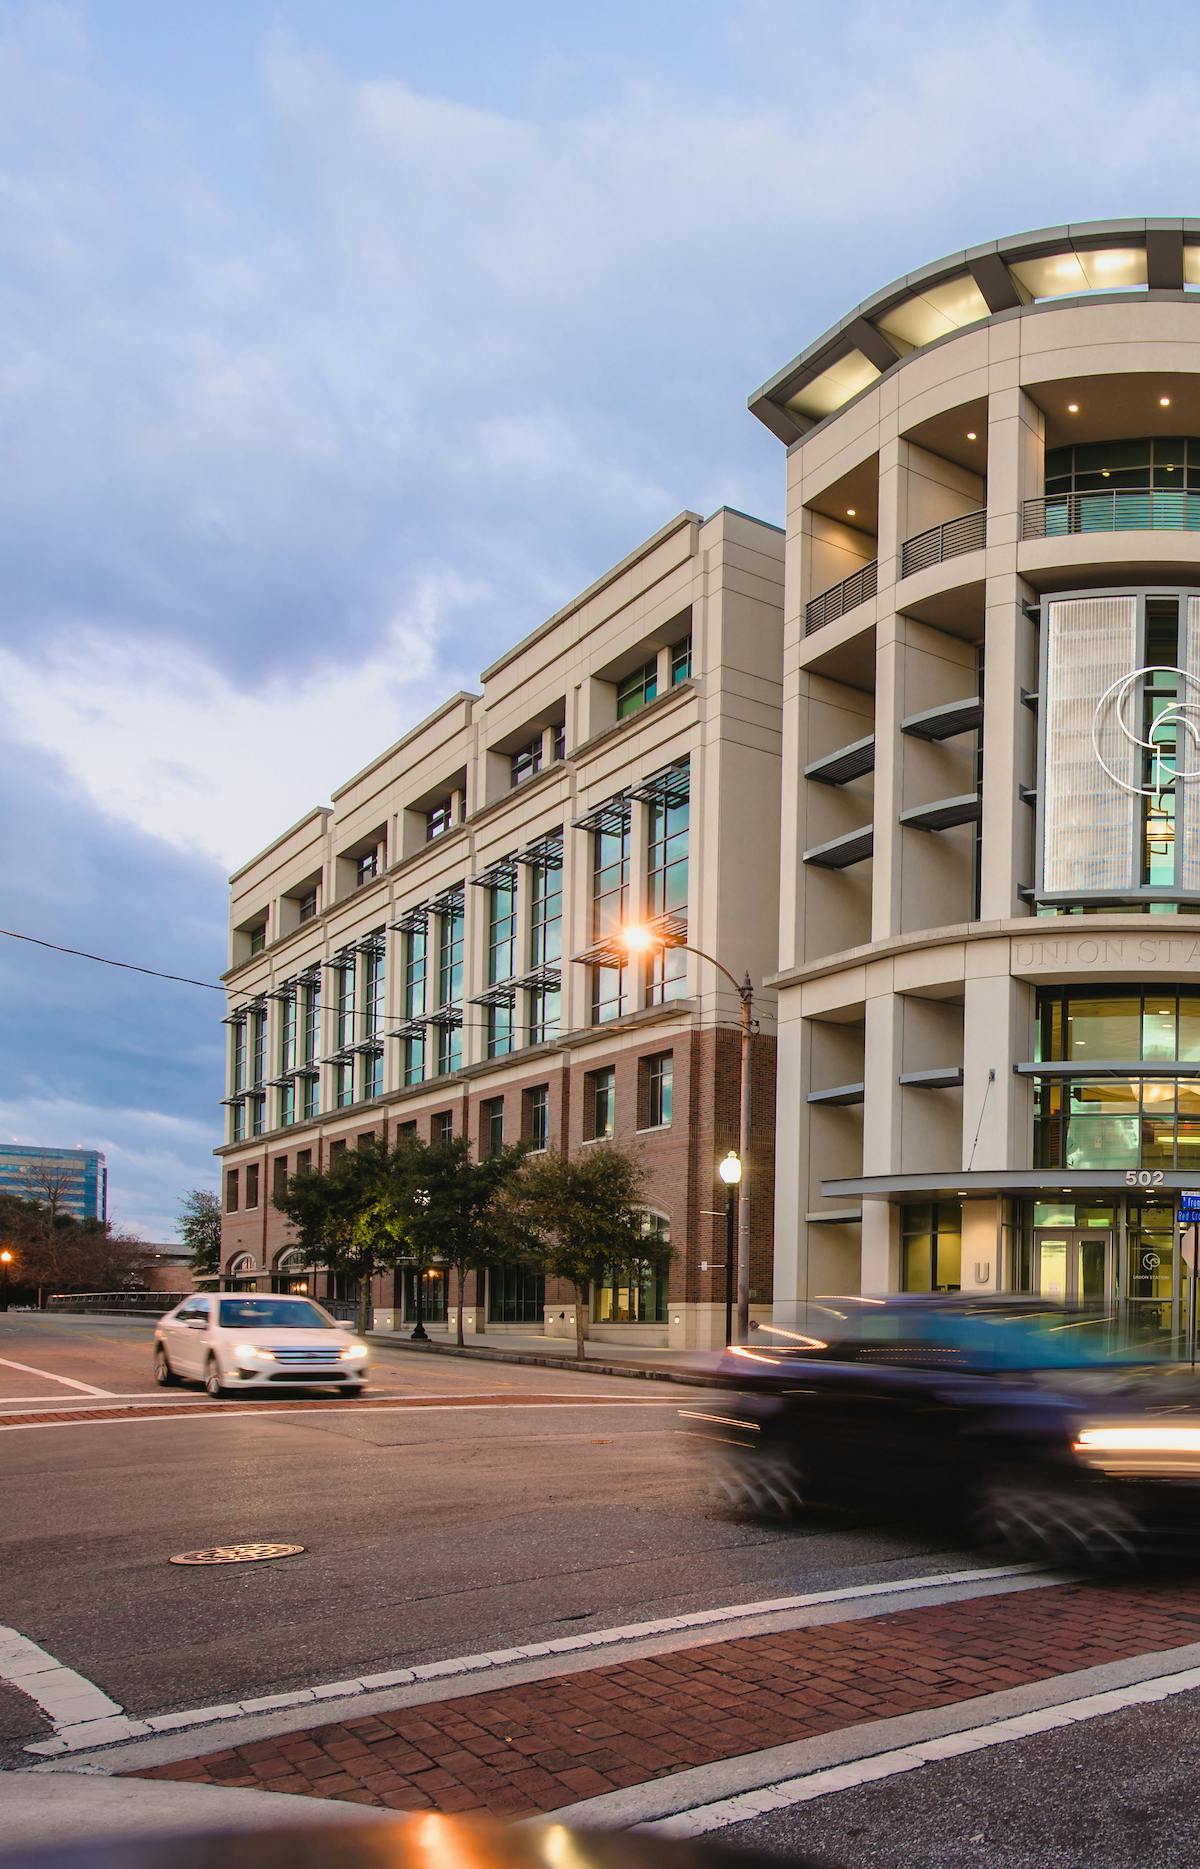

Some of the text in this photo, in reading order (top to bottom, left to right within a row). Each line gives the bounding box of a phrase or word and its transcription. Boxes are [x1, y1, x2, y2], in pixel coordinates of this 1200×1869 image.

[1015, 939, 1127, 967] UNION
[1125, 1170, 1164, 1186] 502
[1178, 1211, 1190, 1221] Red
[975, 1262, 990, 1284] U
